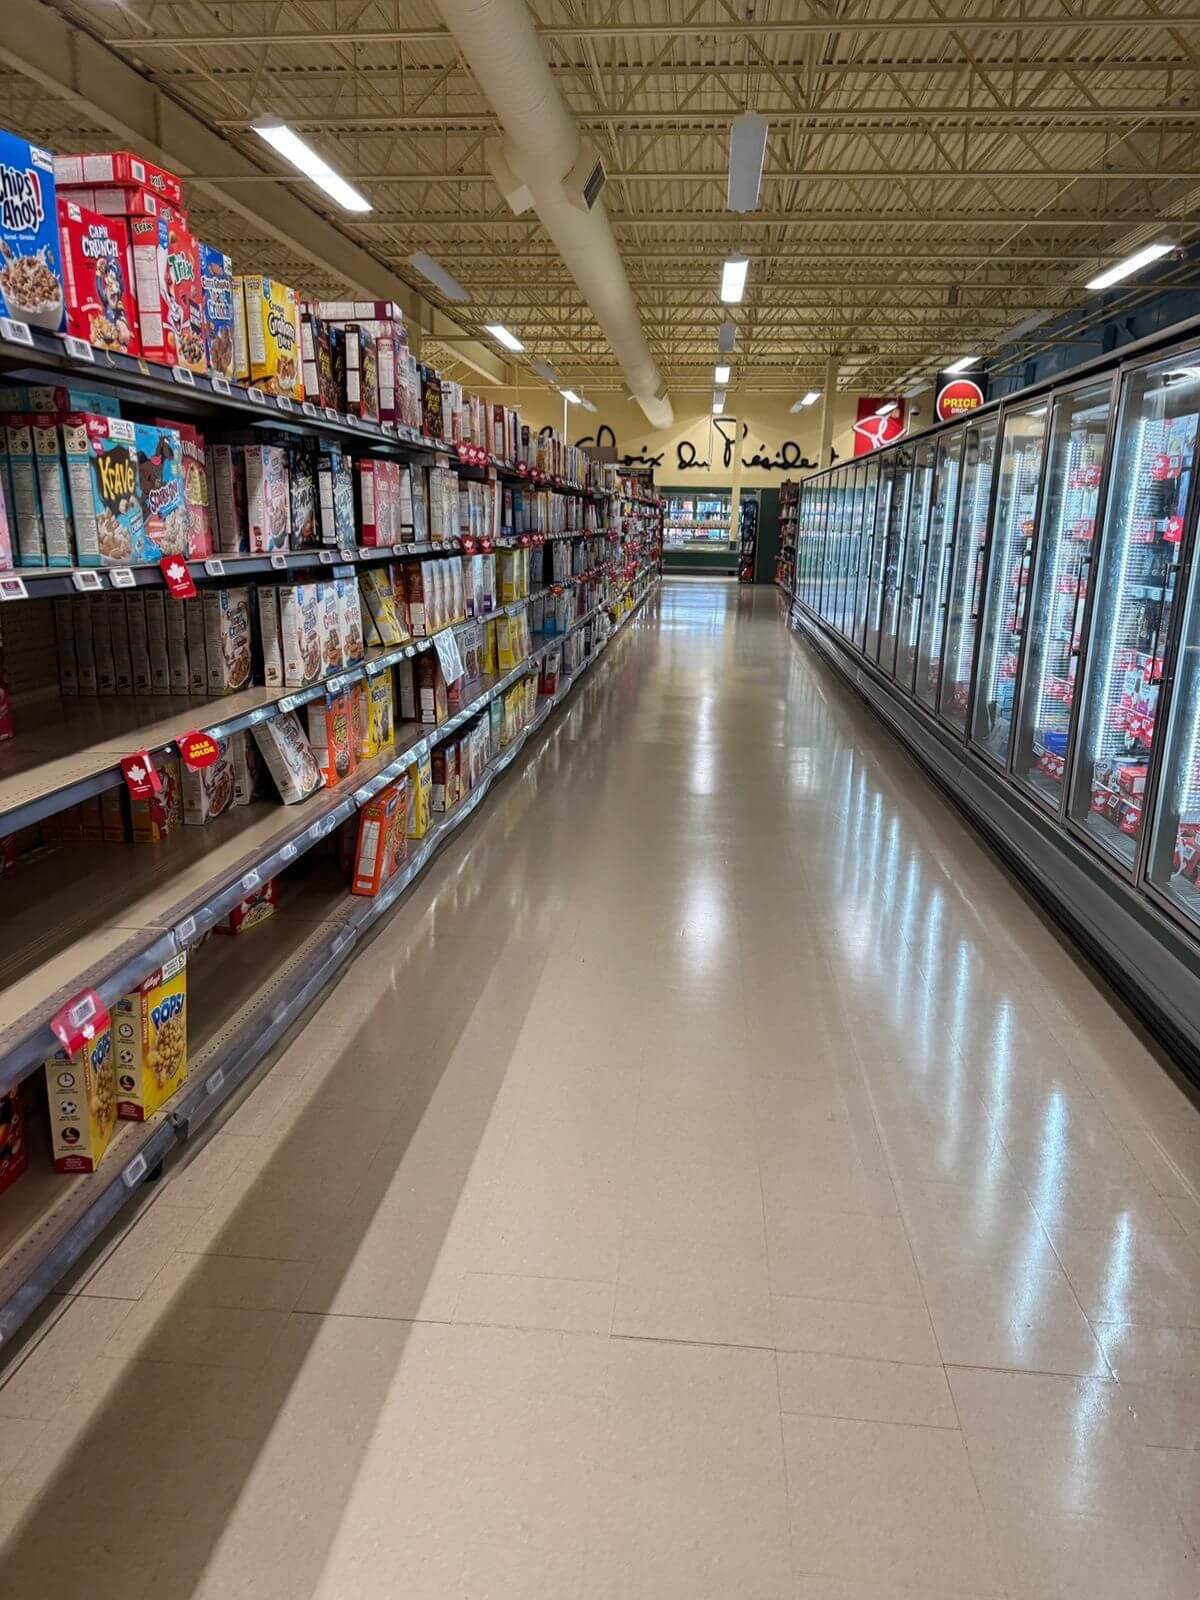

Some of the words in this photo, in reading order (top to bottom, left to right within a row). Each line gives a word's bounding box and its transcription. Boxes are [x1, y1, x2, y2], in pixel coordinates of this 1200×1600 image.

[0, 163, 33, 202] hips
[82, 236, 119, 258] CRUNCH
[168, 251, 195, 284] Trix
[943, 398, 977, 408] PRICE
[189, 746, 215, 759] SOLDE
[190, 740, 209, 751] SALE
